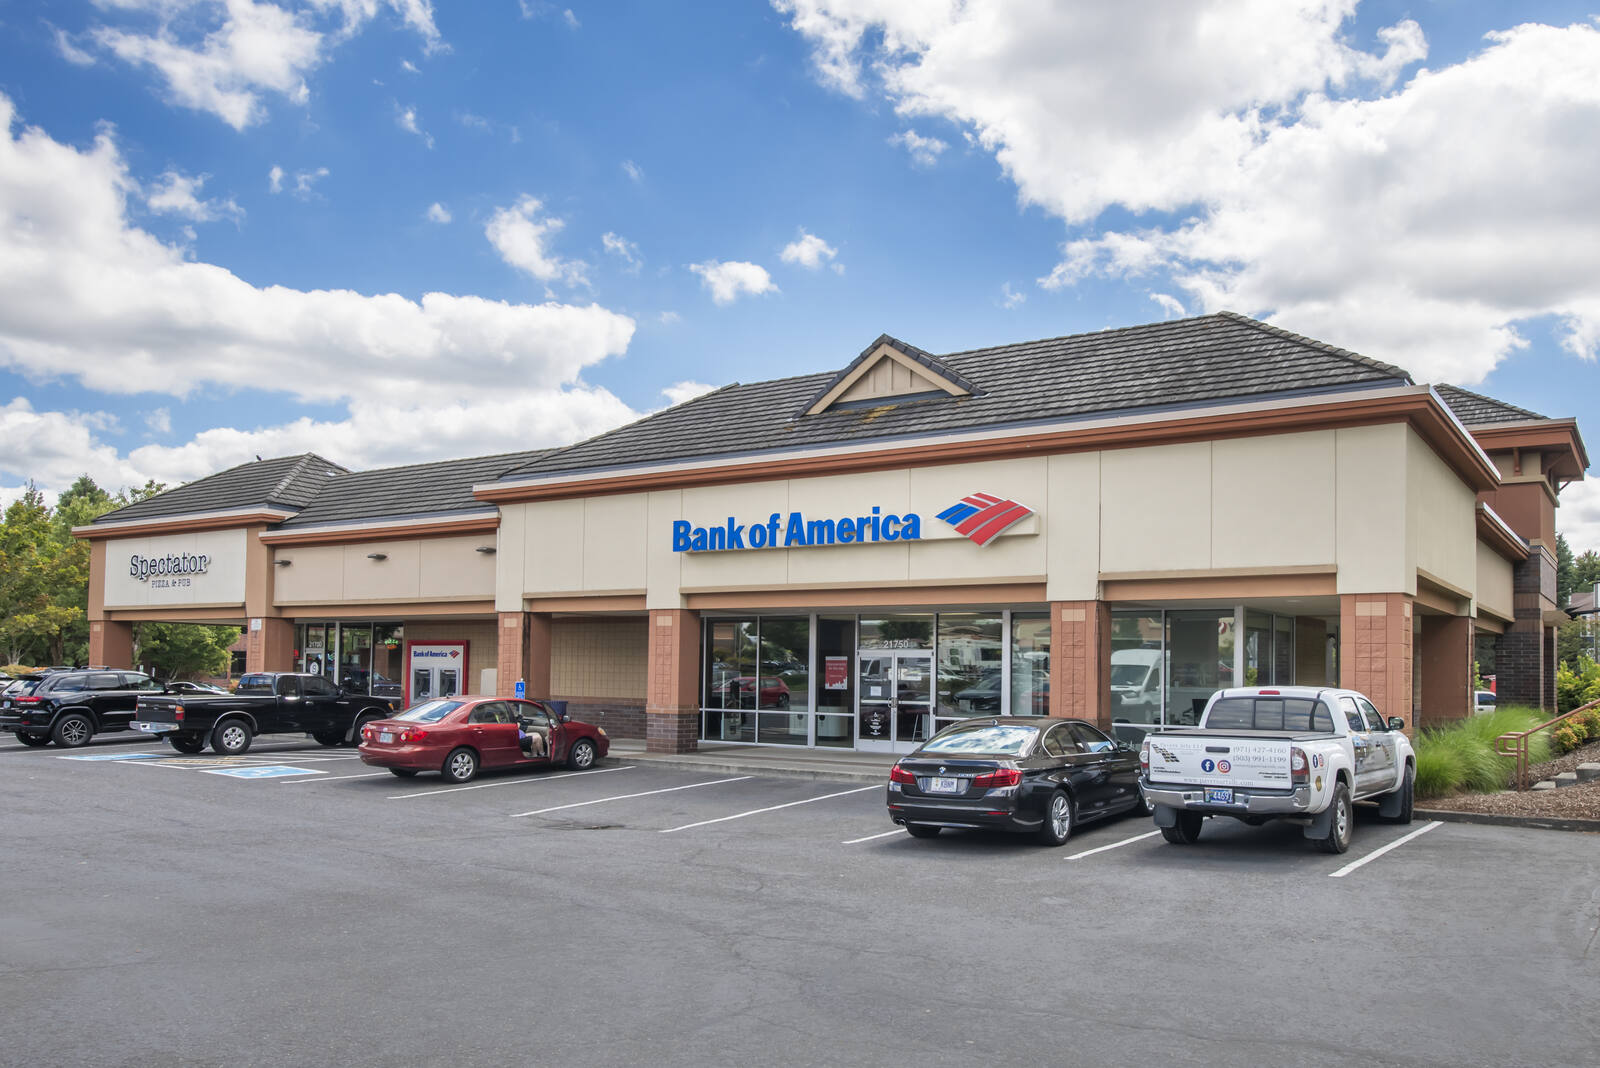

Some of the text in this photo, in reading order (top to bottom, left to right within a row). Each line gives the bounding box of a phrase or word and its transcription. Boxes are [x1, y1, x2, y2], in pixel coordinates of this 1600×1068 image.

[673, 506, 921, 552] Bank of America
[130, 552, 207, 580] Spectator
[883, 640, 908, 648] 21750
